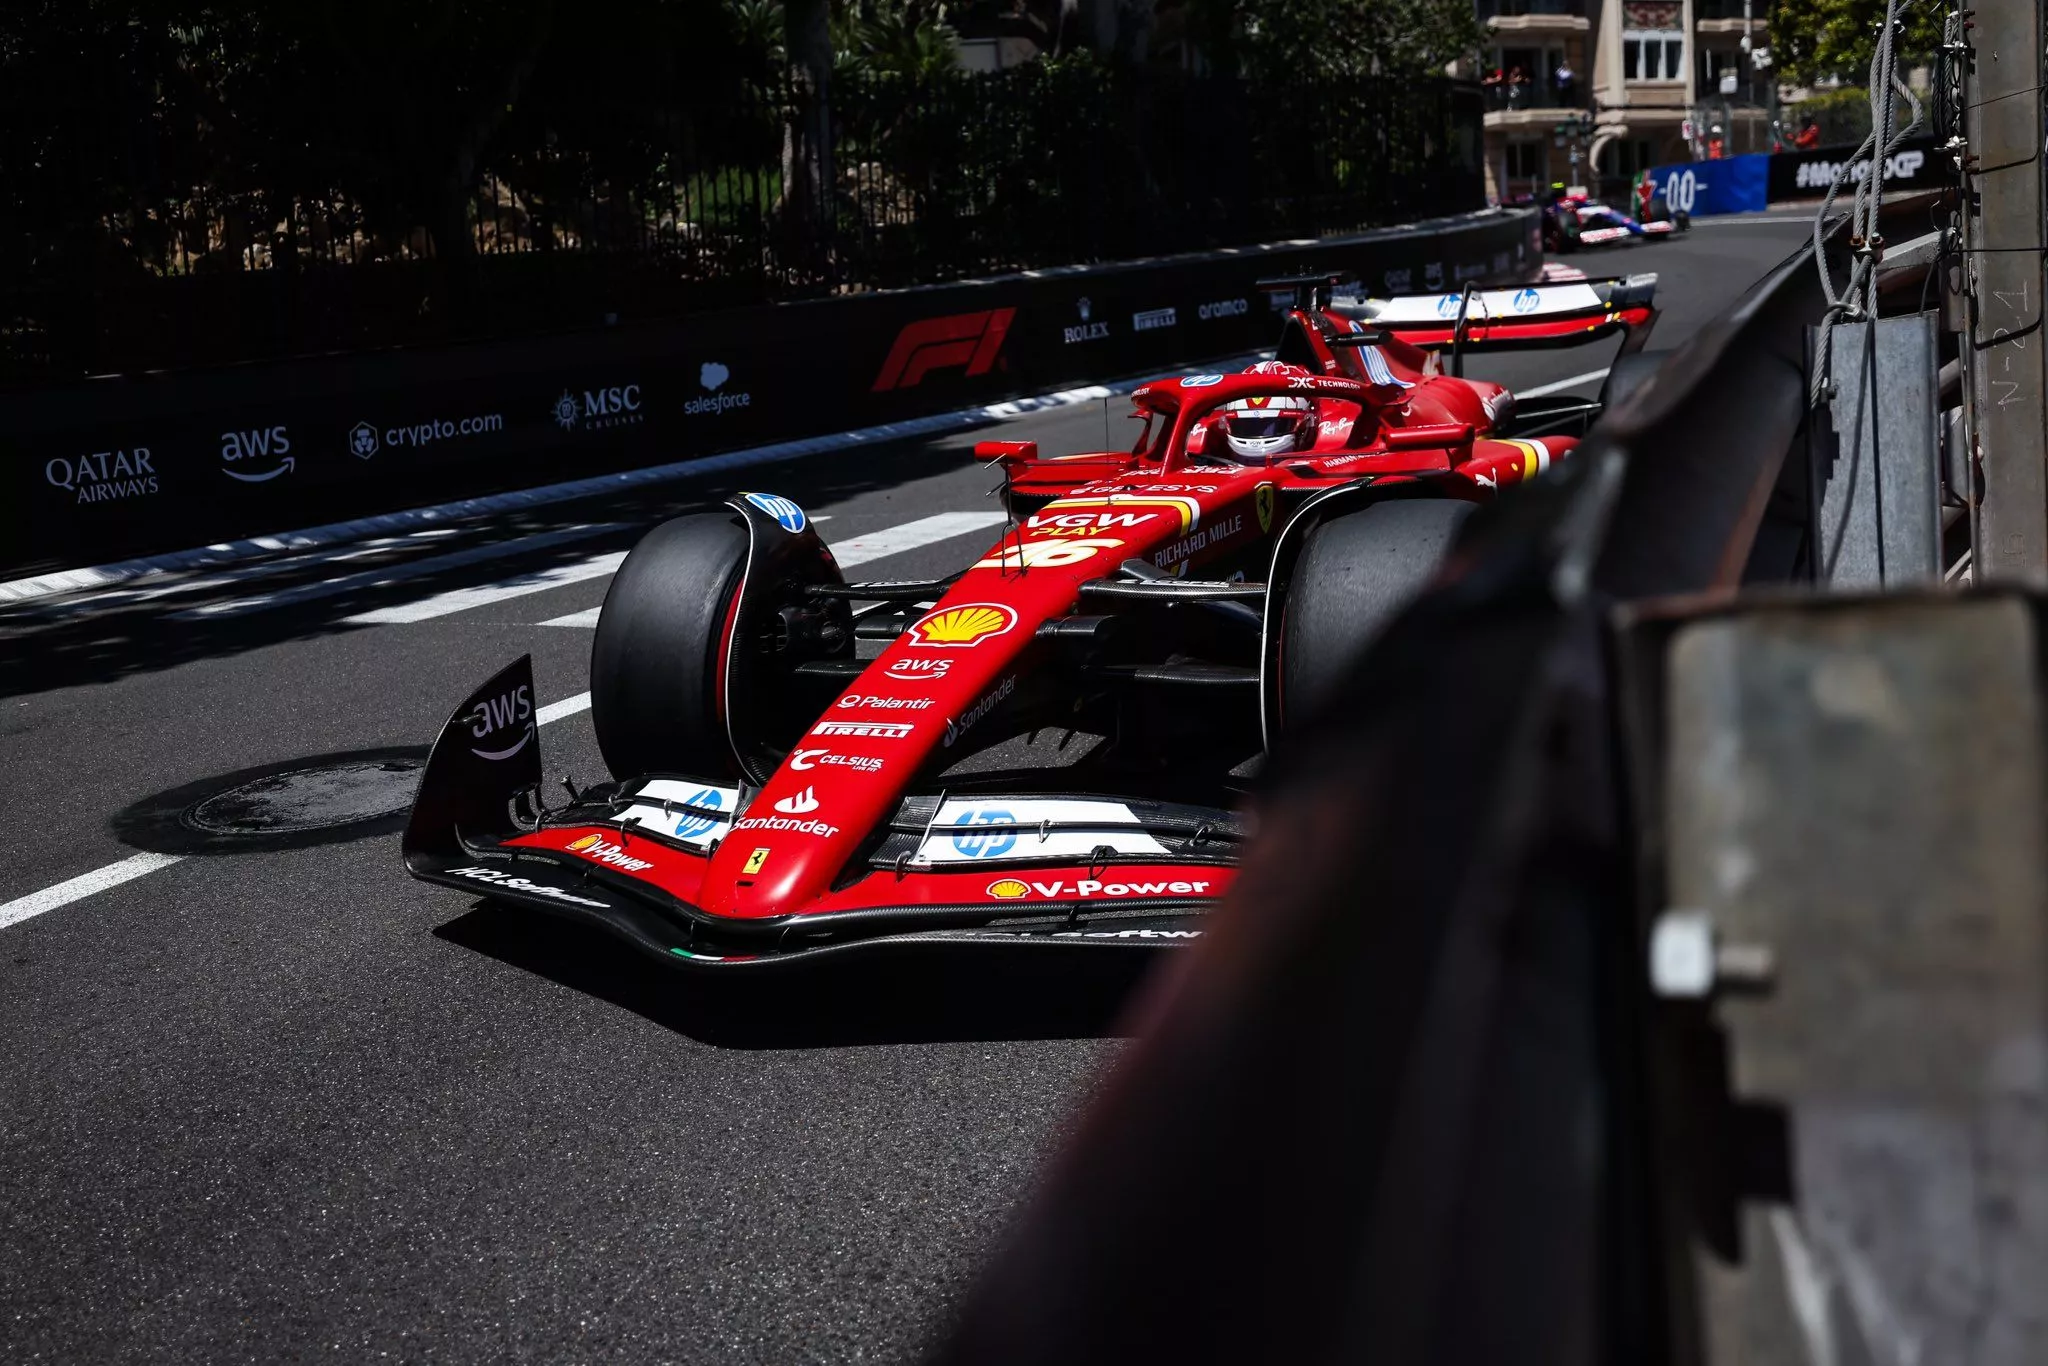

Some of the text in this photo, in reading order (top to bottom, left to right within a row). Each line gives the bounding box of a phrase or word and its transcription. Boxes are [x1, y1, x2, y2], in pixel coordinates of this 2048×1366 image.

[1198, 299, 1248, 320] aramco
[1516, 288, 1538, 312] hp
[1133, 307, 1176, 331] PIRELLI
[1064, 321, 1110, 344] ROLEX
[1317, 379, 1361, 390] TECHNOLOGY
[583, 384, 641, 416] MSC
[684, 392, 750, 415] salesforce
[221, 426, 290, 461] aws
[386, 412, 503, 451] crypto.com
[46, 447, 155, 491] QATAR
[1324, 455, 1357, 468] HARMAN
[77, 476, 159, 504] AIRWAYS
[758, 494, 803, 533] hp
[1027, 513, 1159, 527] VGW
[1029, 526, 1112, 537] PLAY
[1154, 514, 1243, 568] RICHARD MILLE
[891, 658, 954, 671] aws
[473, 685, 531, 738] aws
[859, 695, 935, 710] Palantir
[959, 672, 1018, 735] Santander
[810, 721, 915, 739] PIRELLI
[819, 755, 884, 769] CELSIUS
[729, 814, 840, 839] Santander
[958, 808, 1012, 858] hp
[587, 840, 654, 871] V-Power
[1031, 880, 1210, 898] V-Power
